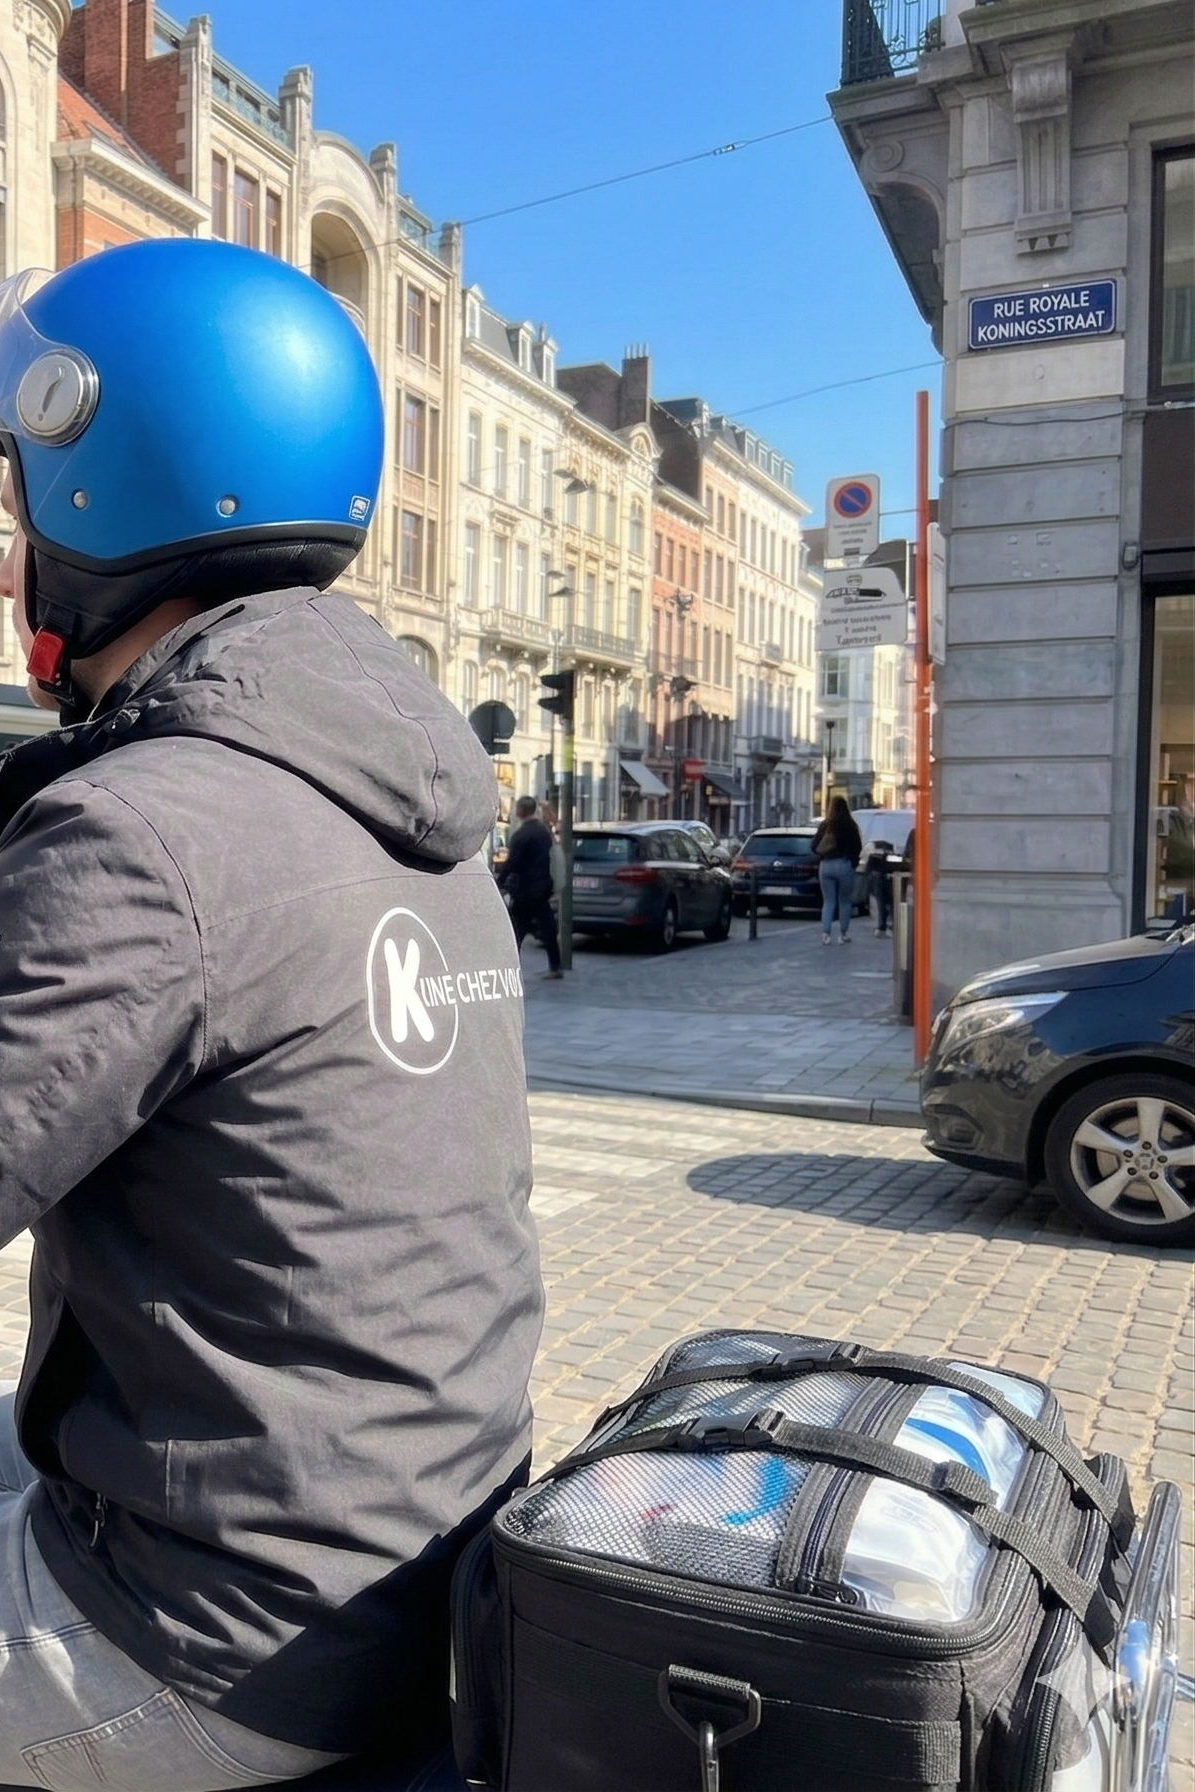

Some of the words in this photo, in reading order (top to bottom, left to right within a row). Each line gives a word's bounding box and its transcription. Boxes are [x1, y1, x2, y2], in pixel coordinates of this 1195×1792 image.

[994, 299, 1025, 319] RUE
[1030, 290, 1090, 314] ROYALE
[978, 310, 1105, 342] KONINGSSTRAAT
[456, 969, 502, 1003] CHEZ
